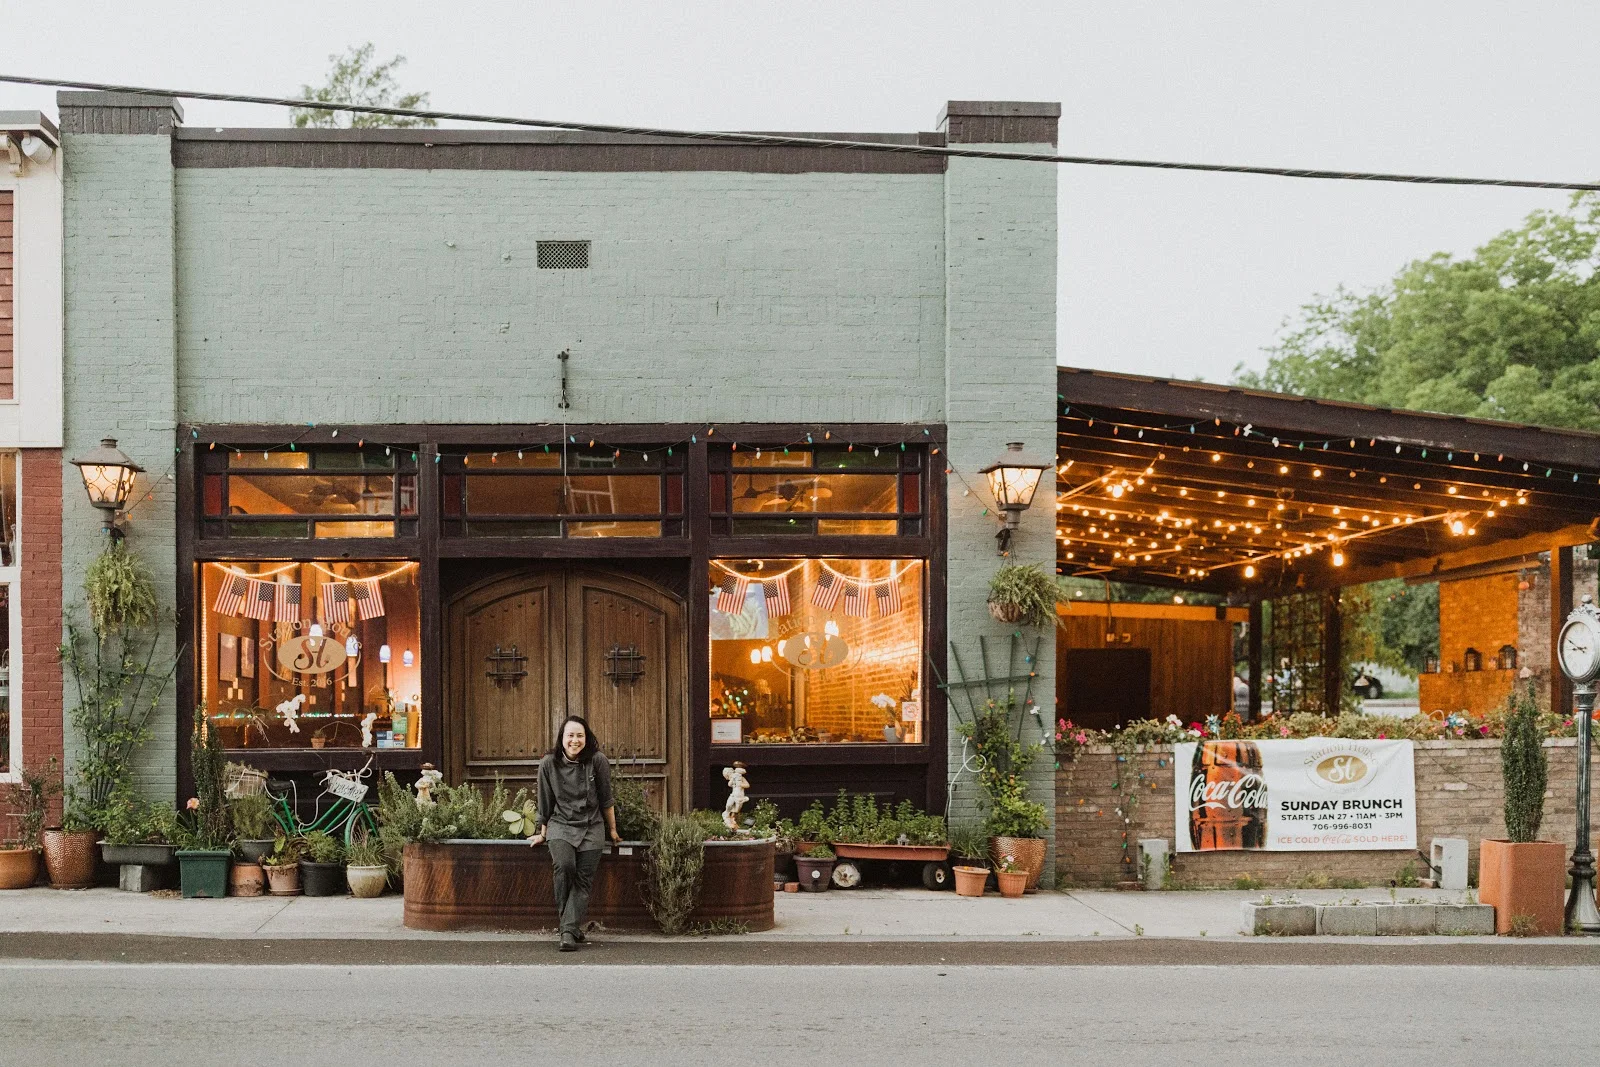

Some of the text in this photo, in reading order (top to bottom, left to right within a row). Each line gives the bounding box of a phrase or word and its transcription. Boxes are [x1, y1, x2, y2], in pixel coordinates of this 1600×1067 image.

[310, 677, 333, 687] 206
[1189, 774, 1268, 811] Coca-Cola
[1281, 799, 1403, 811] SUNDAY BRUNCH
[1312, 822, 1372, 830] 706-996-8031
[1277, 836, 1292, 844] ICE
[1294, 836, 1320, 844] COLD
[1353, 835, 1379, 843] SOLD
